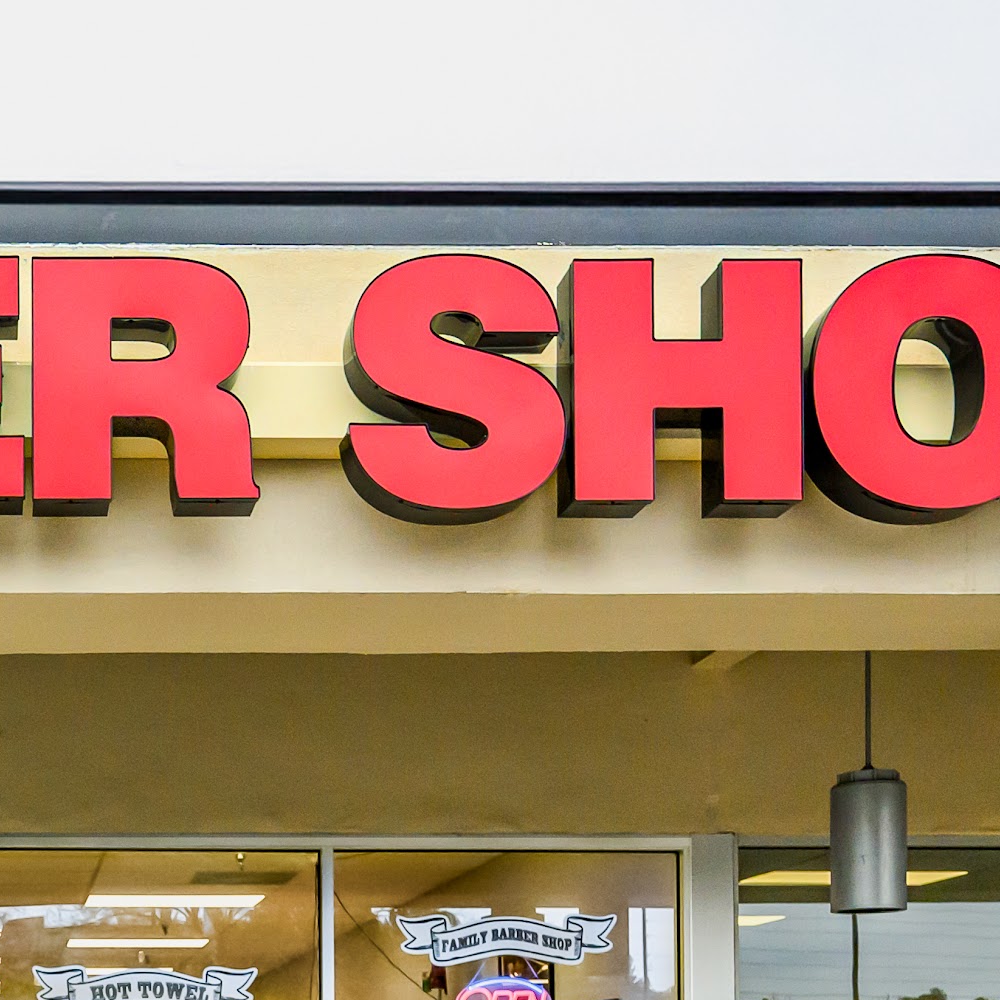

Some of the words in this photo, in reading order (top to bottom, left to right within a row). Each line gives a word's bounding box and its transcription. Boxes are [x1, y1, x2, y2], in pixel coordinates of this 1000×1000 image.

[441, 930, 488, 953] FAMILY
[491, 928, 539, 945] BARBER
[541, 933, 573, 951] SHOP
